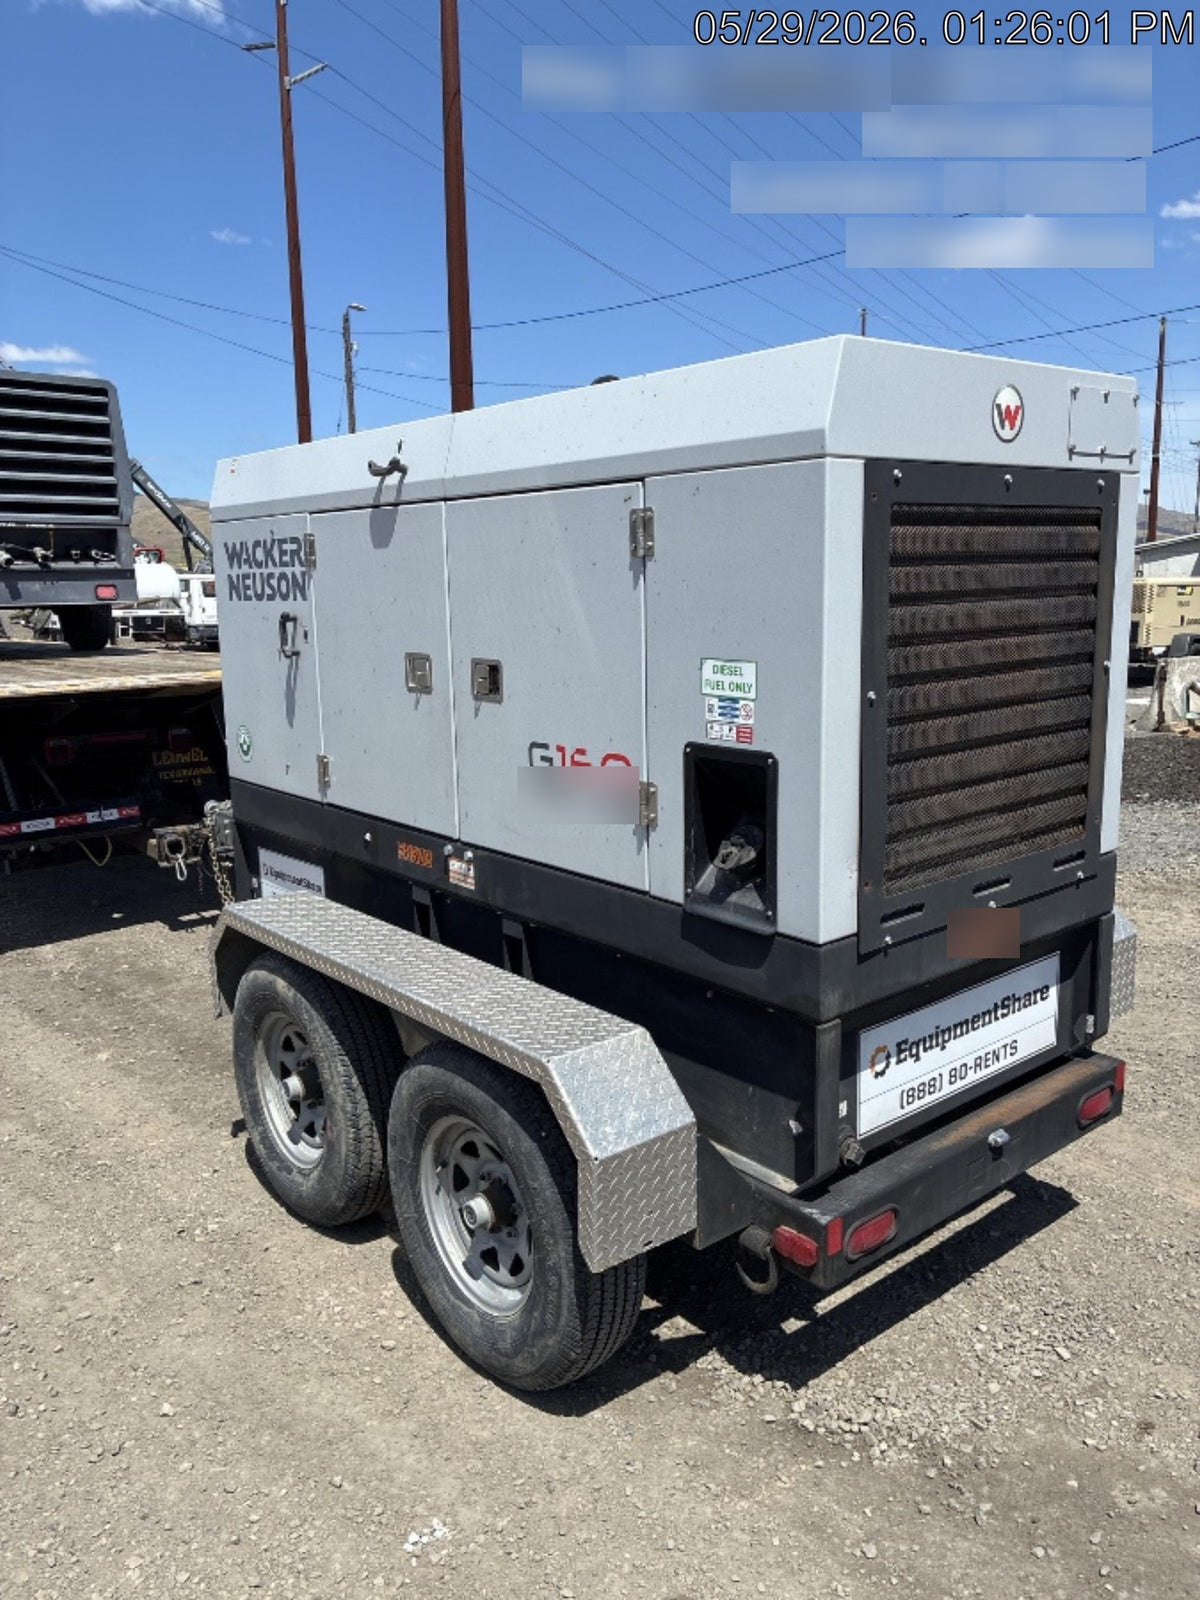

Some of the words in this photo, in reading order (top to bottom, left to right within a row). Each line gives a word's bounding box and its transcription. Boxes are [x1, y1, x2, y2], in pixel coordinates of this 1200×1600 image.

[223, 536, 305, 570] WACKER
[227, 570, 308, 602] NEUSON
[705, 678, 725, 691] FUEL
[728, 681, 753, 694] ONLY
[712, 664, 743, 677] DIESEL
[895, 983, 1050, 1064] EquipmentShare
[900, 1072, 944, 1110] (888)
